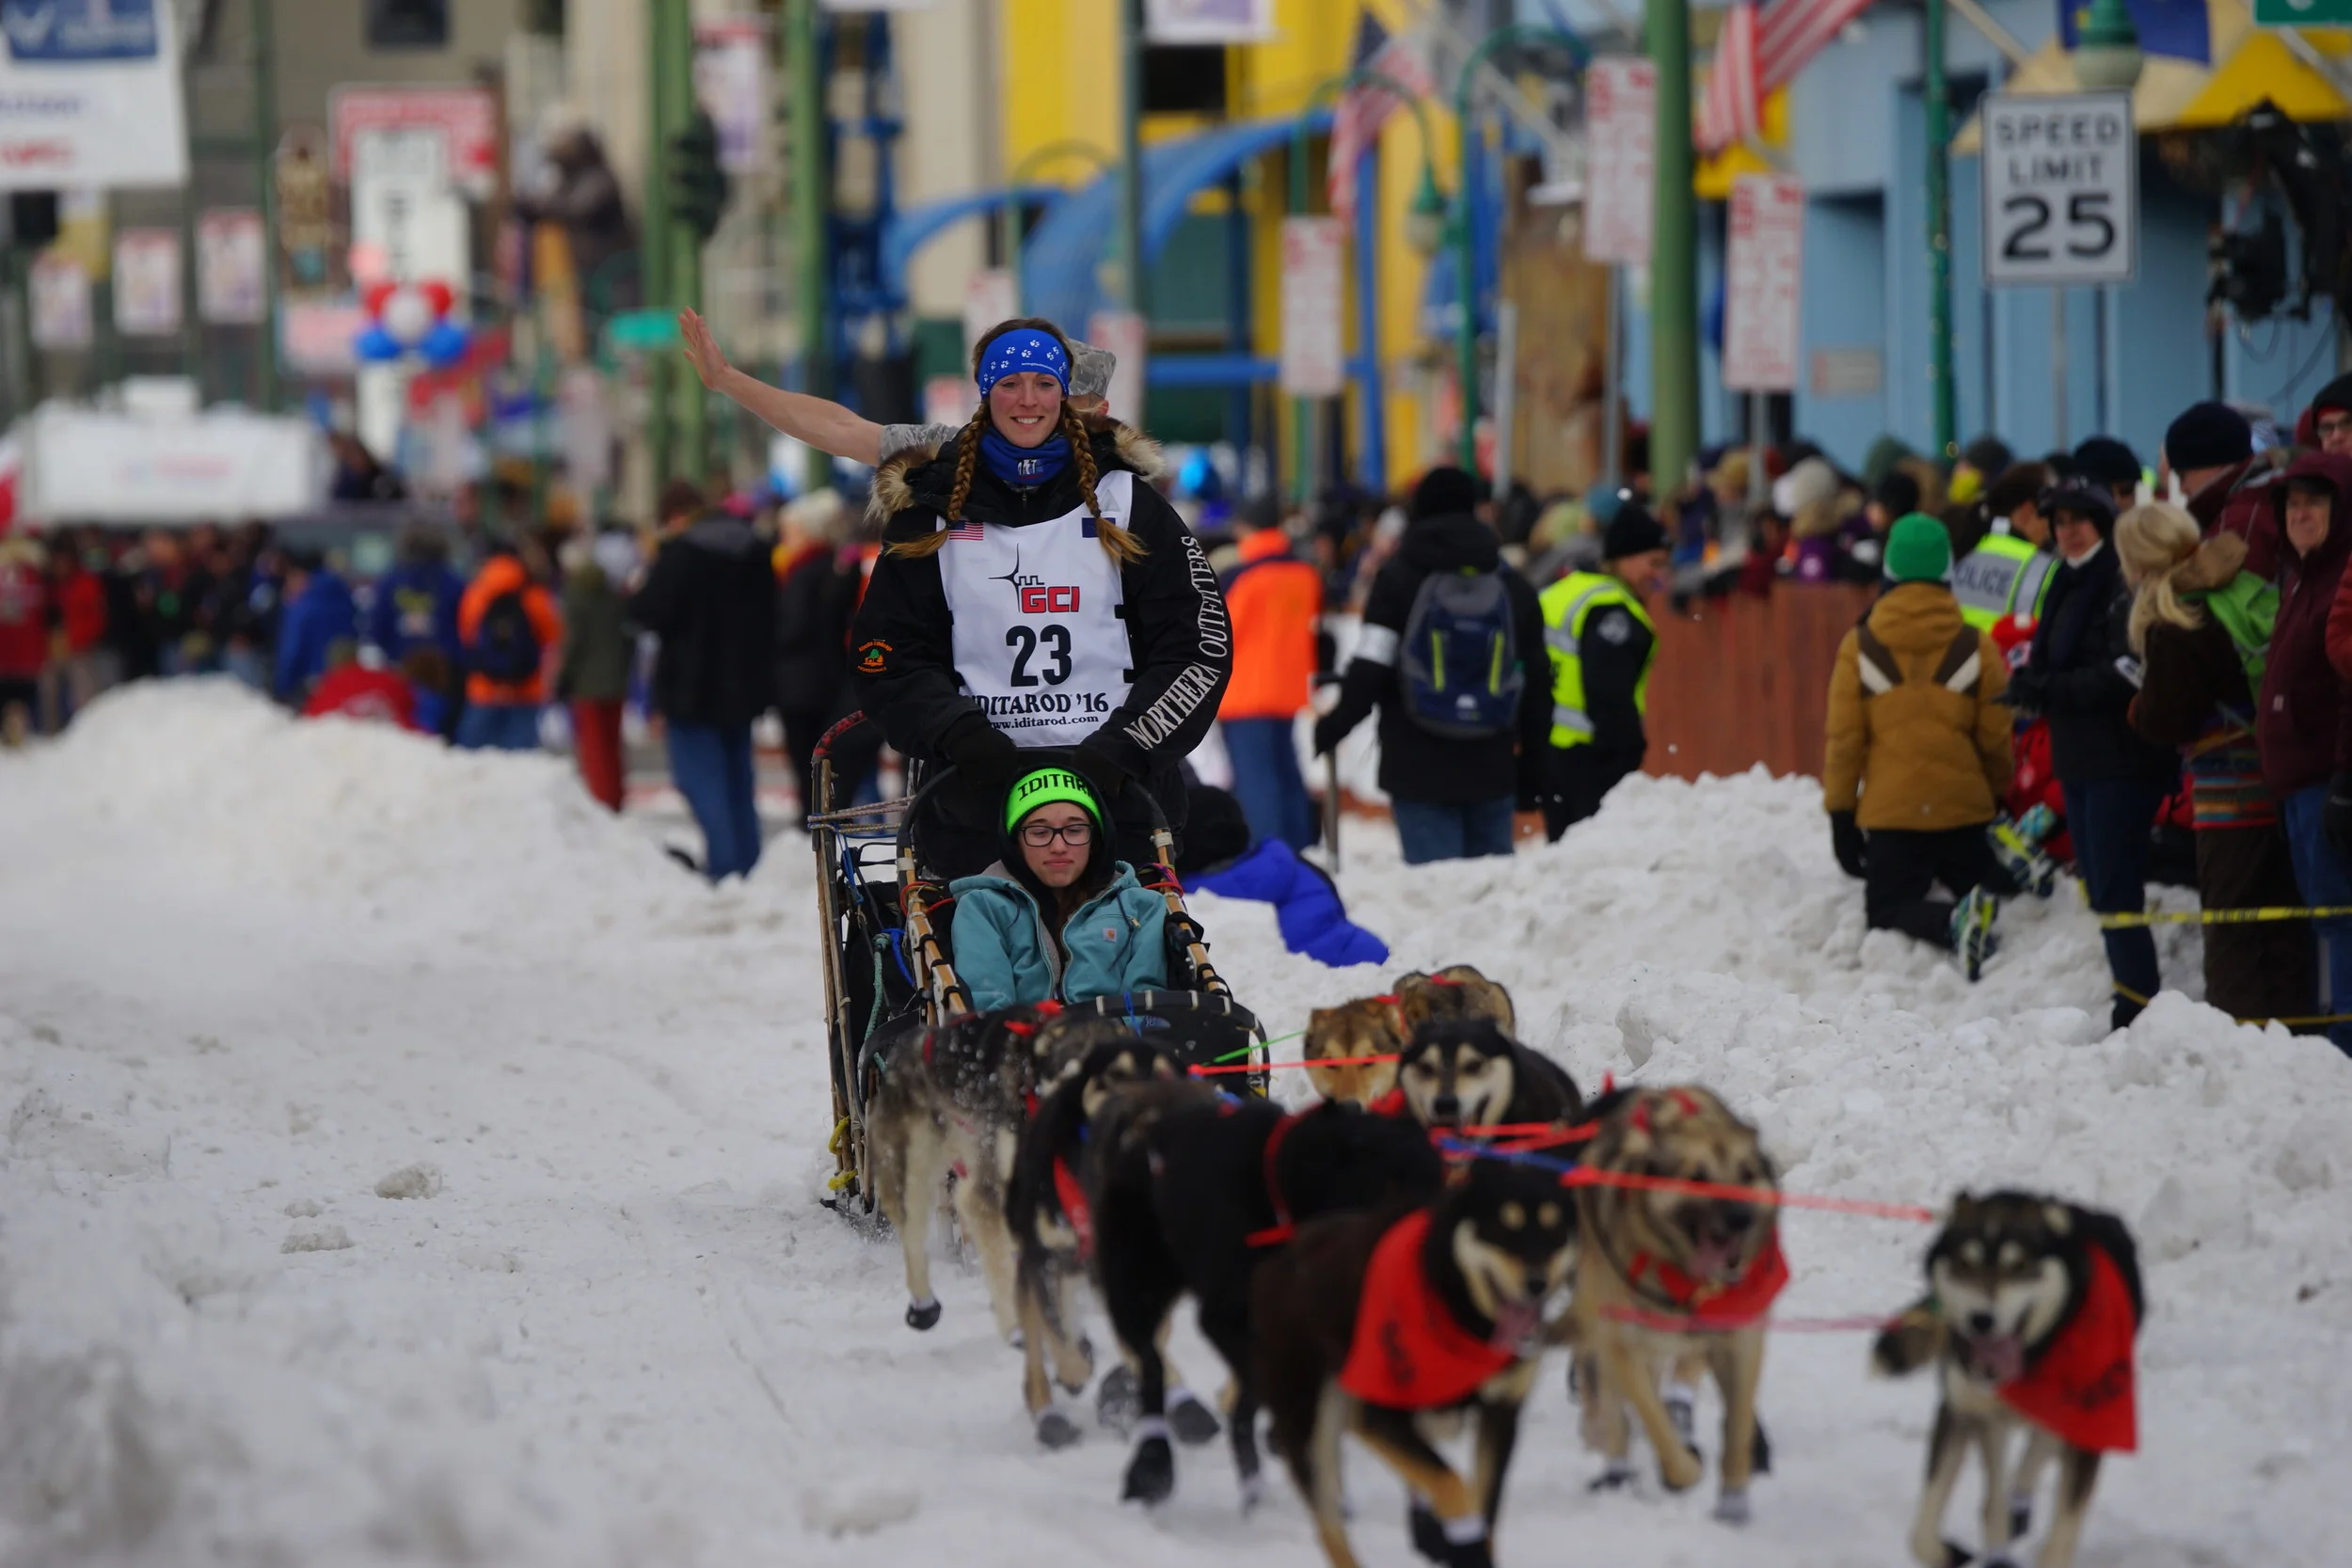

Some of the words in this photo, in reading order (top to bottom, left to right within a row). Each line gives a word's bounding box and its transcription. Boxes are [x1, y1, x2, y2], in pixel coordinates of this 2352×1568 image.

[1995, 114, 2121, 149] SPEED
[2009, 154, 2102, 185] LIMIT
[2002, 192, 2118, 261] 25
[1181, 535, 1228, 657] OUTFITTERS
[1955, 562, 2013, 599] OLICE
[1021, 586, 1080, 613] GCI
[1005, 624, 1073, 688] 23
[1076, 692, 1109, 713] '16
[990, 715, 1099, 730] ww.iditarod.com
